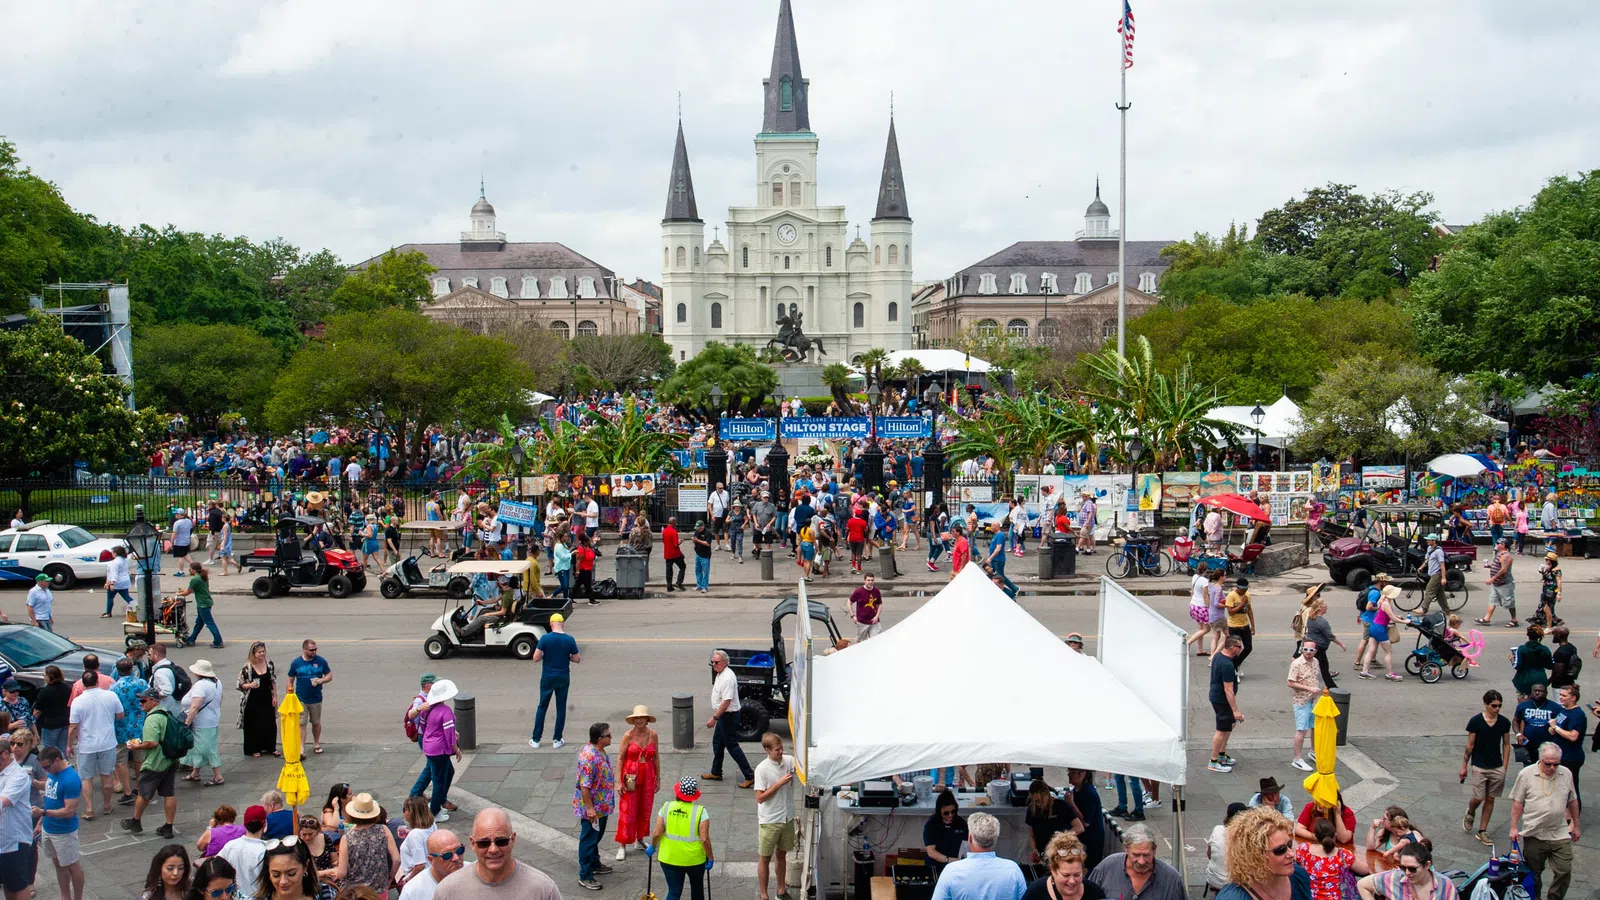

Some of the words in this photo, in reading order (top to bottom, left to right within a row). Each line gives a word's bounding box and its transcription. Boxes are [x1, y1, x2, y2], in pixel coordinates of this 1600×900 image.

[732, 424, 763, 433] Hilton
[785, 423, 826, 432] HILTON
[829, 423, 867, 432] STAGE
[888, 422, 919, 431] Hilton
[501, 503, 514, 511] FOOD
[515, 505, 535, 515] VENDOR
[500, 509, 521, 518] LOADING
[520, 513, 534, 521] ZONE
[1524, 708, 1552, 720] SPIRIT
